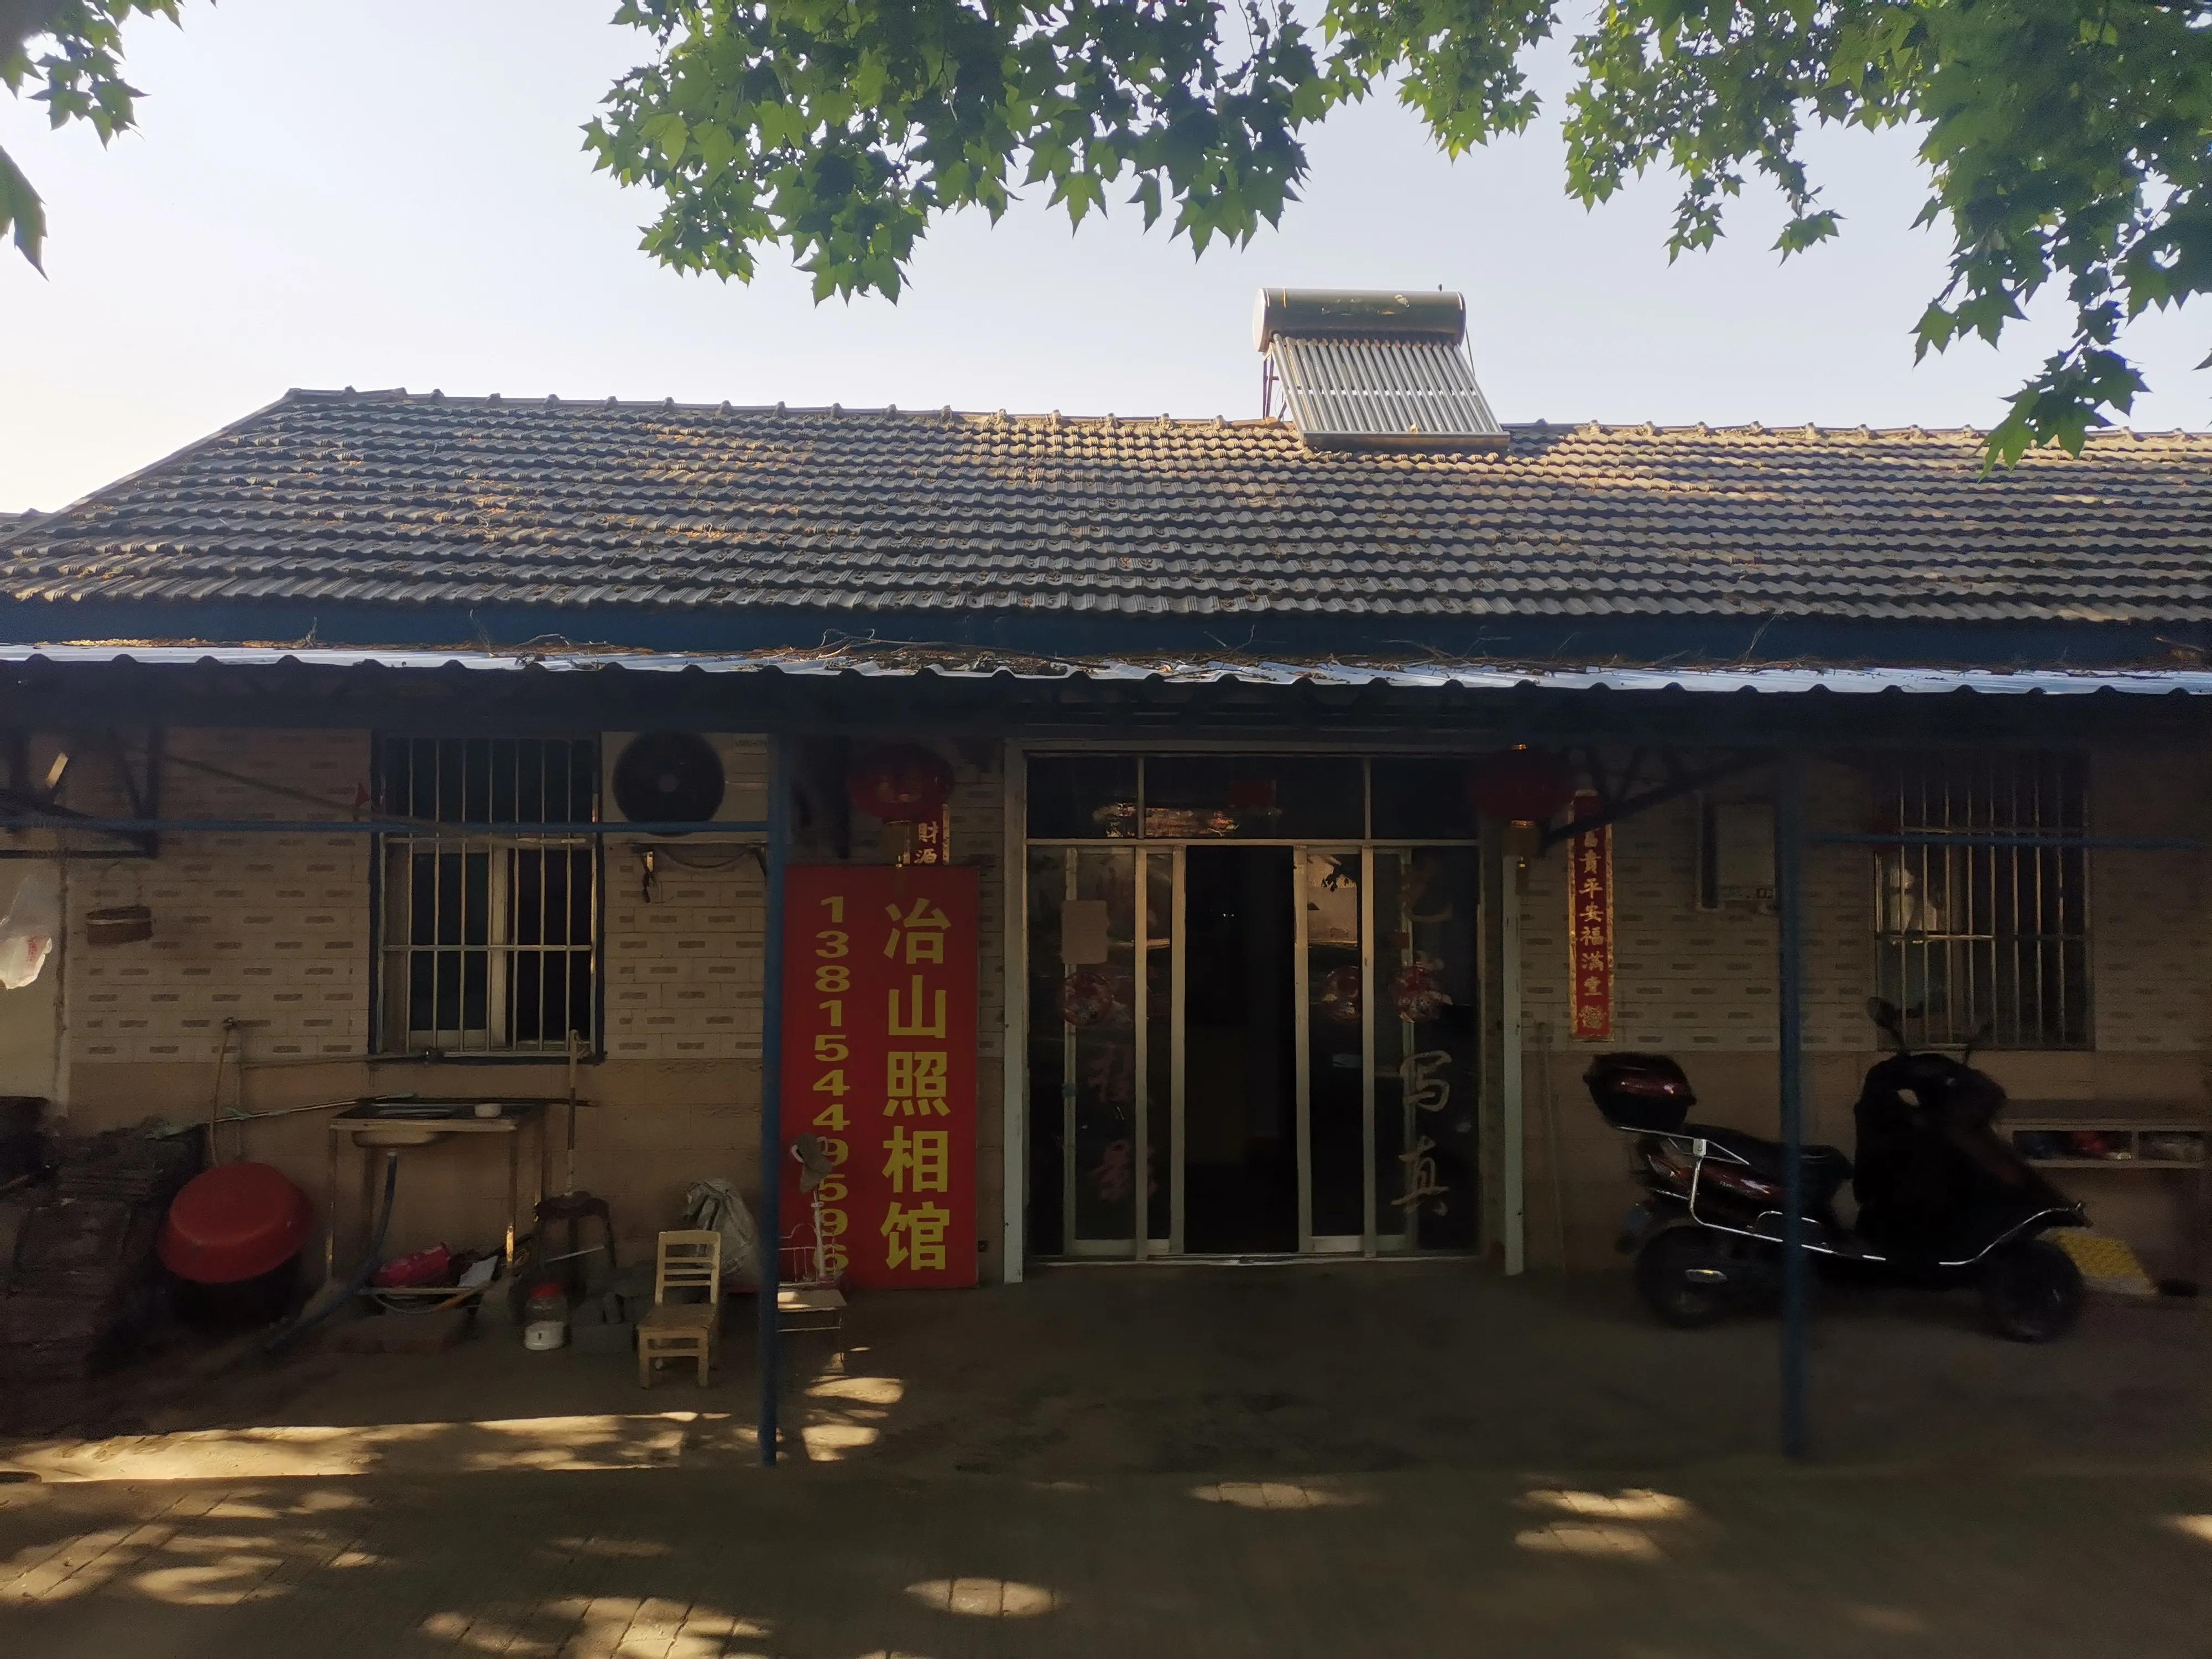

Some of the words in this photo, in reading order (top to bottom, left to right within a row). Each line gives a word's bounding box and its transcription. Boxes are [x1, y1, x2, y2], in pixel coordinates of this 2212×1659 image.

[880, 898, 952, 1270] 冶山照相馆
